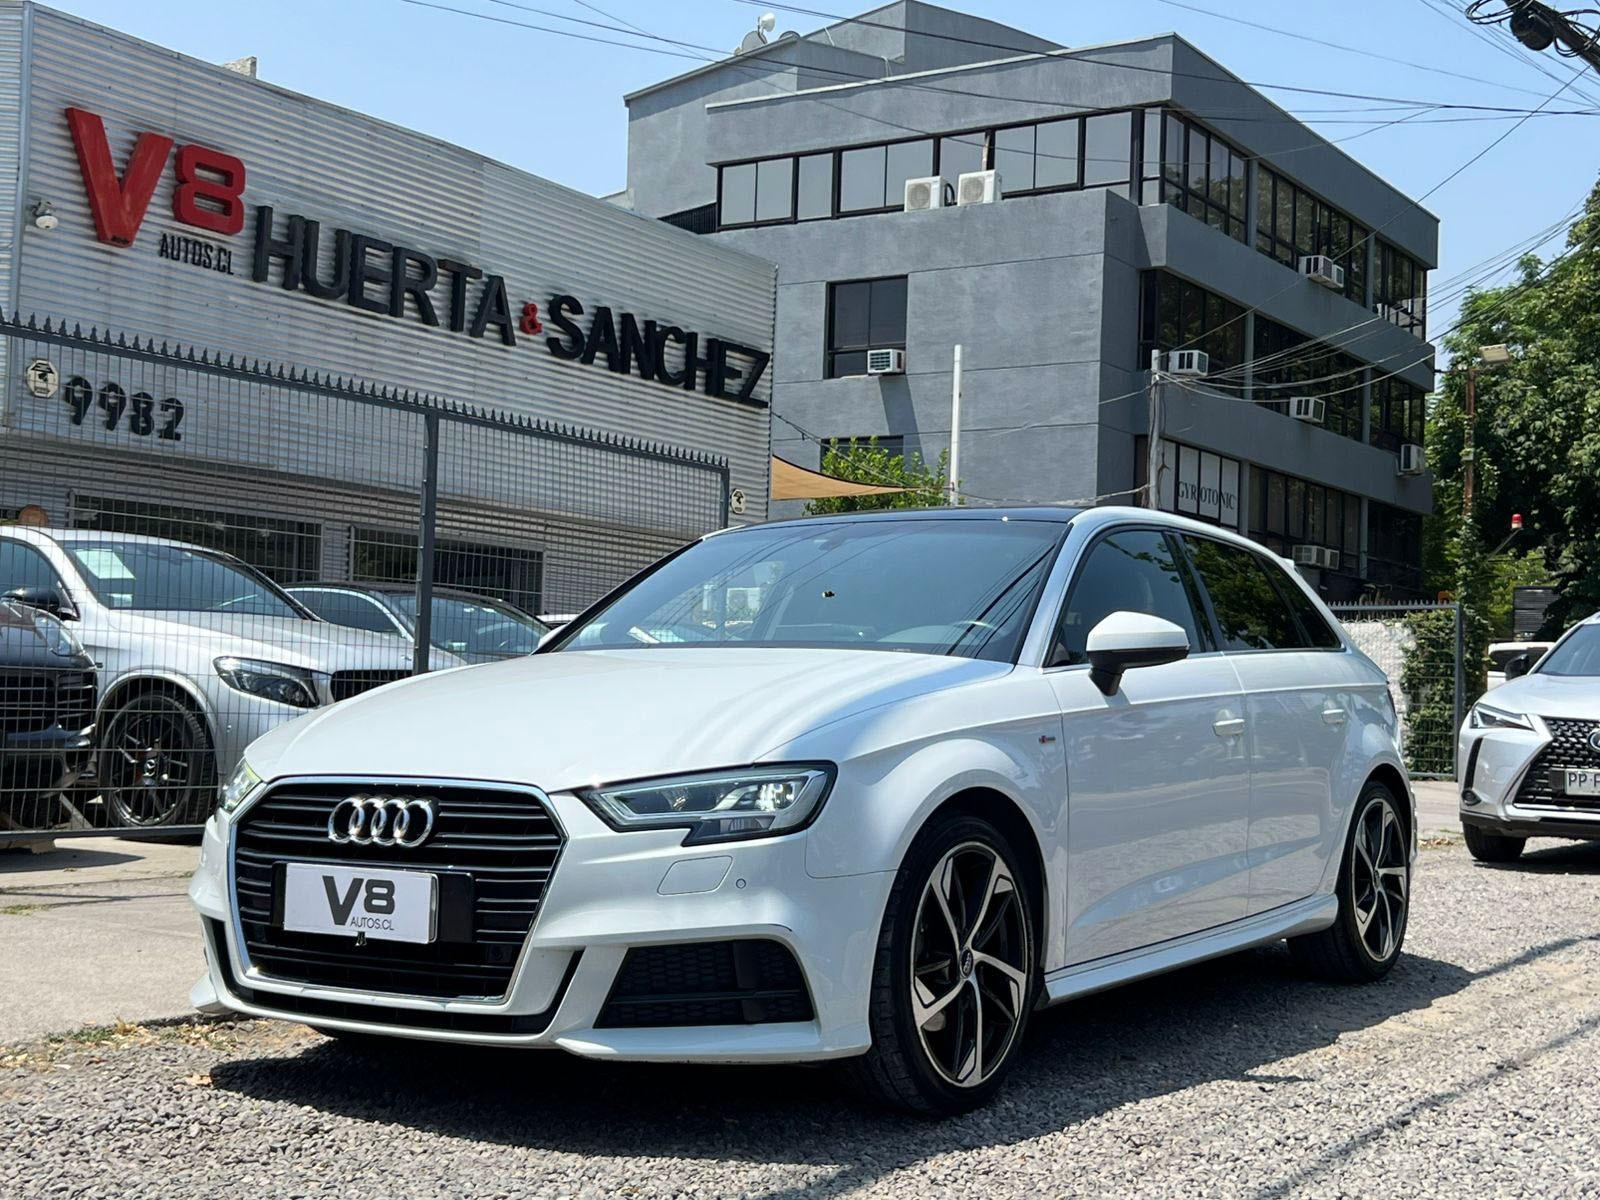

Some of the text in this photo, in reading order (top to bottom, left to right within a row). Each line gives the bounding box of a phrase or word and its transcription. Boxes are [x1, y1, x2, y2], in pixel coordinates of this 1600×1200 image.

[65, 107, 246, 249] V8
[159, 233, 234, 275] AUTOS.CL
[252, 205, 771, 408] HUERTA & SANCHEZ
[64, 375, 185, 441] 9982
[1178, 481, 1236, 509] GYROTONIC
[322, 875, 395, 926] V8
[350, 917, 395, 931] AUTOS.CL
